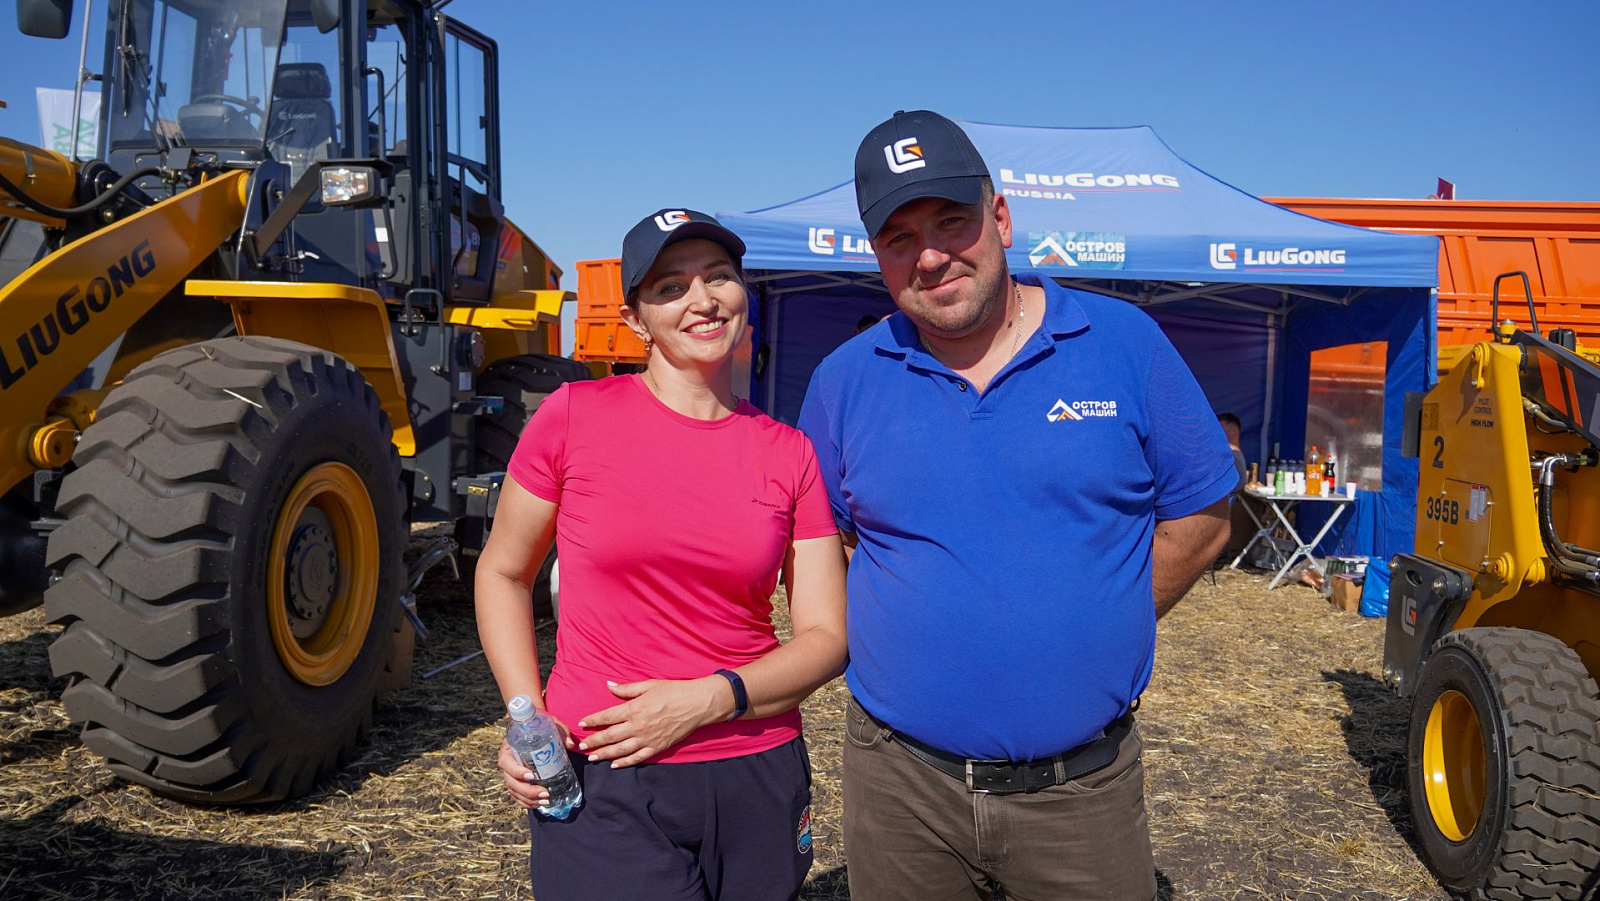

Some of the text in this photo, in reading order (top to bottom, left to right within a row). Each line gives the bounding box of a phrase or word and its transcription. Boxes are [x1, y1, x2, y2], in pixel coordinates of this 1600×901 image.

[1002, 188, 1076, 200] RUSSIA
[842, 235, 876, 254] LIU
[1065, 240, 1126, 253] ОСТРОВ
[1077, 252, 1125, 263] МАШИН
[0, 238, 157, 391] LIUGONG
[1072, 401, 1117, 410] ОСТРОВ
[1081, 409, 1118, 417] МАШИН
[1432, 435, 1445, 469] 2
[1426, 496, 1459, 526] 395B
